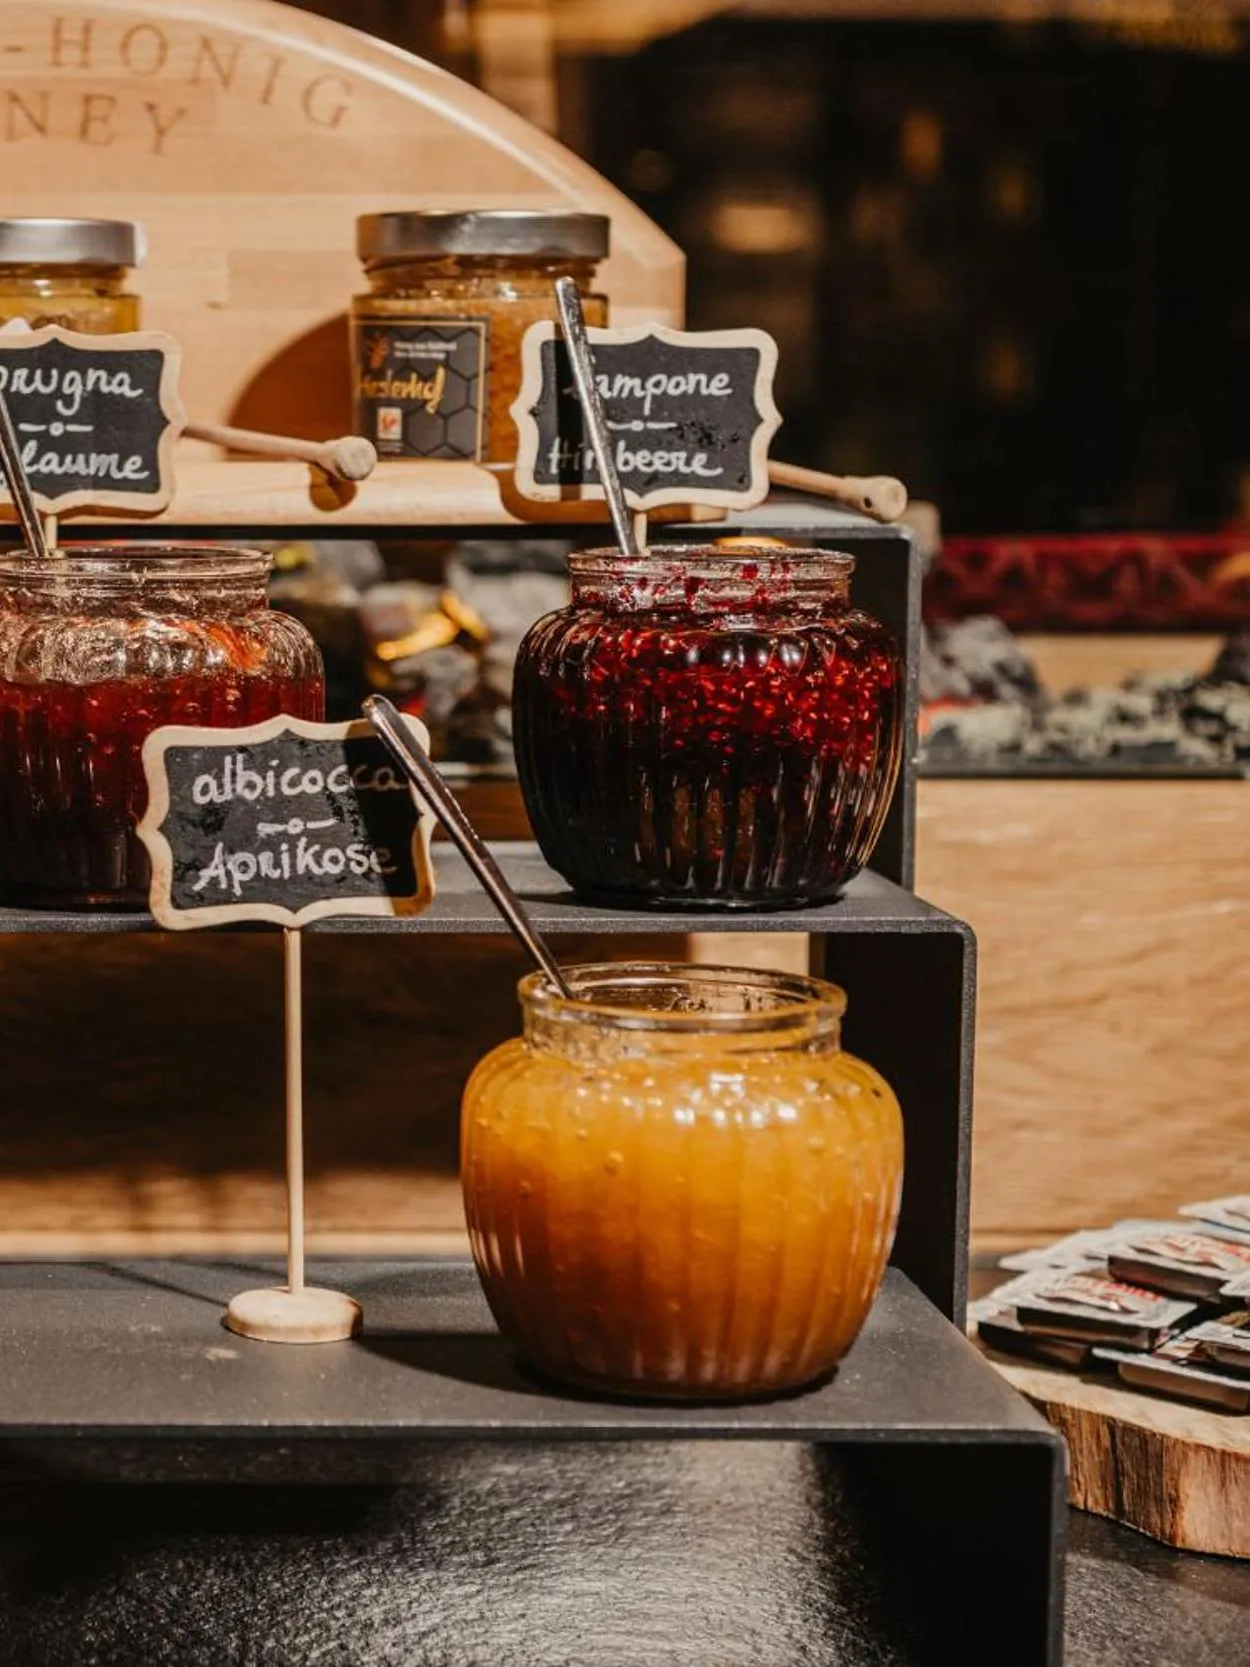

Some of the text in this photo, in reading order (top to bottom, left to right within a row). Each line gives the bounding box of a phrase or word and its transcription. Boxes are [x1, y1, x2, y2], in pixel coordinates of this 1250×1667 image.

[563, 371, 734, 417] ampone
[191, 752, 410, 805] albicocca
[190, 837, 399, 897] Aprikose
